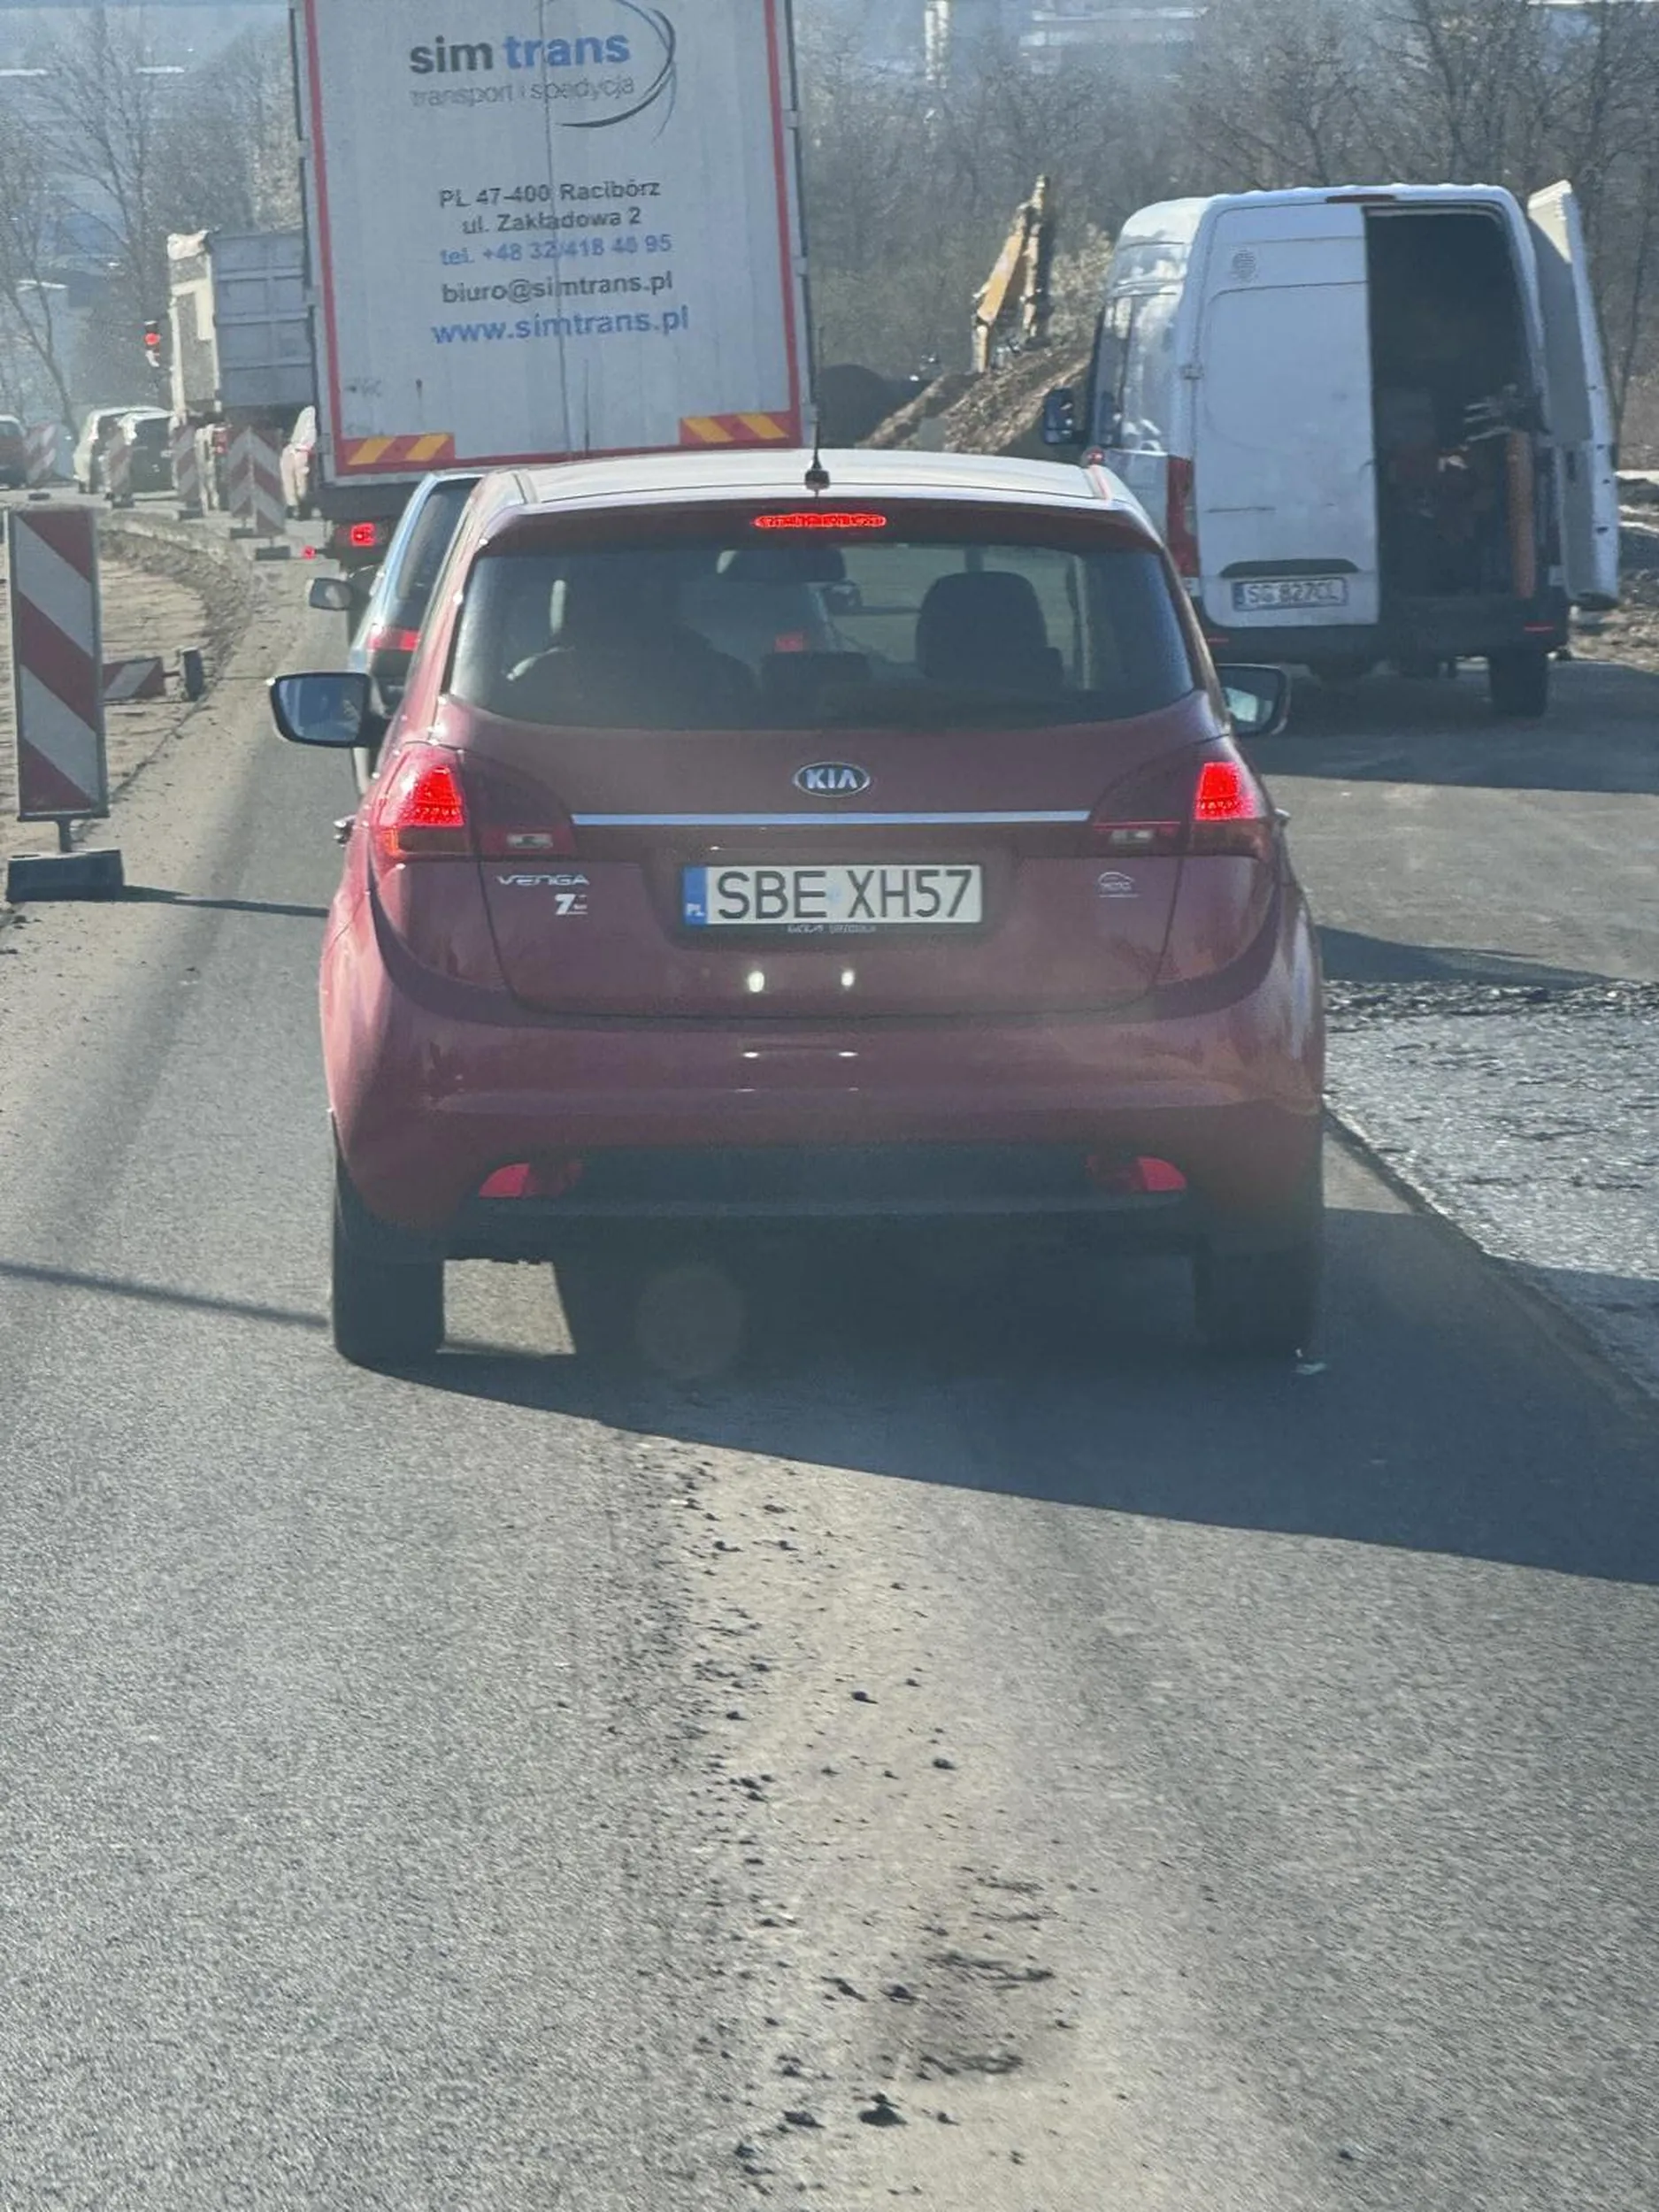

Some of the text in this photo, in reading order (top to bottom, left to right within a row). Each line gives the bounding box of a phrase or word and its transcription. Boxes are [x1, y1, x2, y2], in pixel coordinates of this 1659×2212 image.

[409, 35, 631, 73] sim trans
[408, 84, 512, 107] transport
[441, 188, 471, 207] PL
[476, 185, 550, 205] 47-400
[628, 206, 641, 224] 2
[483, 242, 523, 261] +48
[645, 234, 672, 252] 95
[442, 271, 673, 303] biuro@simtrans.pl
[431, 305, 689, 344] www.simtrans.pl
[805, 768, 858, 789] KIA
[496, 874, 590, 886] VENGA
[718, 869, 972, 919] SBE XH57
